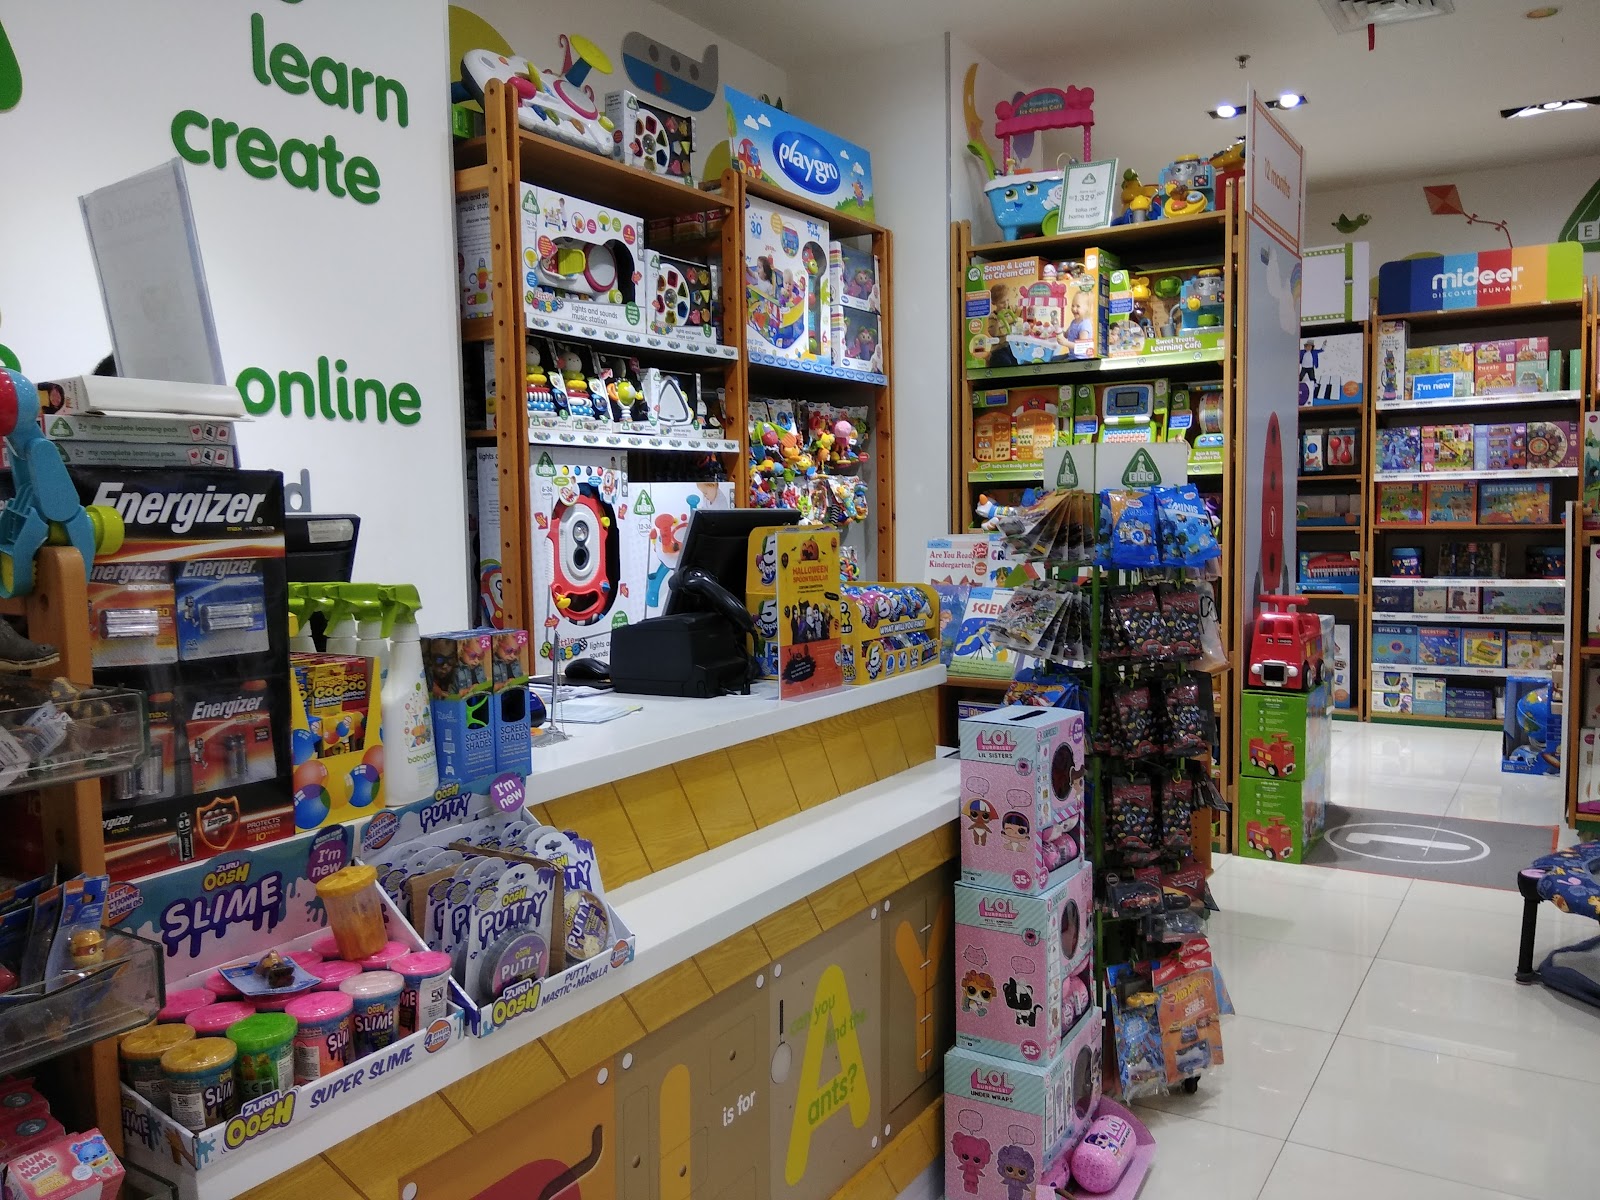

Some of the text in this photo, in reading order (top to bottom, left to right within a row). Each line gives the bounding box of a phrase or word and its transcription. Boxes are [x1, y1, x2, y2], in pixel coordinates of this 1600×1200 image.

[251, 12, 408, 127] learn
[171, 110, 380, 204] create
[779, 140, 838, 184] playgro
[750, 221, 762, 235] 30
[984, 264, 1006, 273] Scoop
[1014, 260, 1036, 268] Learn
[994, 270, 1018, 279] Cream
[1019, 268, 1036, 276] Cart
[1432, 266, 1524, 291] mideer
[572, 313, 608, 325] music station
[600, 310, 618, 319] sounds
[236, 356, 422, 425] online
[1416, 382, 1451, 392] I'm new
[103, 424, 134, 434] complete
[135, 424, 158, 434] learning
[160, 426, 178, 434] pack
[100, 449, 132, 458] complete
[132, 450, 157, 458] learning
[158, 450, 176, 458] pack
[1130, 472, 1153, 482] ELC
[92, 482, 266, 534] Energizer
[943, 550, 956, 559] You
[91, 563, 166, 584] nergizer
[182, 560, 257, 580] Energizer
[792, 565, 829, 575] HALLOWEEN
[930, 560, 974, 571] Kindergarten?
[972, 602, 1005, 615] SCIEN
[481, 639, 491, 649] 2+
[518, 634, 528, 644] 2+
[590, 640, 604, 651] lights
[590, 650, 609, 660] sounds
[191, 695, 265, 721] Energizer
[466, 729, 493, 744] SCREEN
[500, 723, 528, 735] SCREEN
[466, 740, 493, 752] SHADES
[500, 732, 529, 744] SHADES
[436, 784, 459, 800] OOSH
[494, 778, 516, 797] I'm
[500, 790, 524, 810] new
[420, 793, 471, 826] PUTTY
[102, 814, 134, 830] ergizer
[246, 816, 281, 829] PROTECTS
[317, 849, 341, 864] I'm
[216, 860, 240, 874] ZURU
[312, 862, 342, 878] new
[204, 864, 250, 891] OOSH
[1014, 874, 1030, 884] 35+
[502, 889, 527, 906] OOSH
[164, 875, 278, 938] SLIME
[481, 892, 546, 938] PUTTY
[568, 896, 590, 948] PUTTY
[502, 950, 542, 978] PUTTY
[564, 964, 591, 984] PUTTY
[504, 984, 531, 998] ZURU
[492, 987, 541, 1025] OOSH
[814, 995, 836, 1023] you
[354, 1009, 394, 1032] SLIME
[1023, 1045, 1040, 1056] 35+
[311, 1044, 417, 1109] SUPER SLIME
[807, 1063, 858, 1125] ants?
[970, 1090, 1014, 1104] UNDER WRAPS
[245, 1092, 280, 1118] ZURU
[723, 1090, 756, 1126] is for
[227, 1094, 295, 1146] OOSH
[16, 1152, 47, 1171] NUM
[20, 1155, 58, 1180] NOMS
